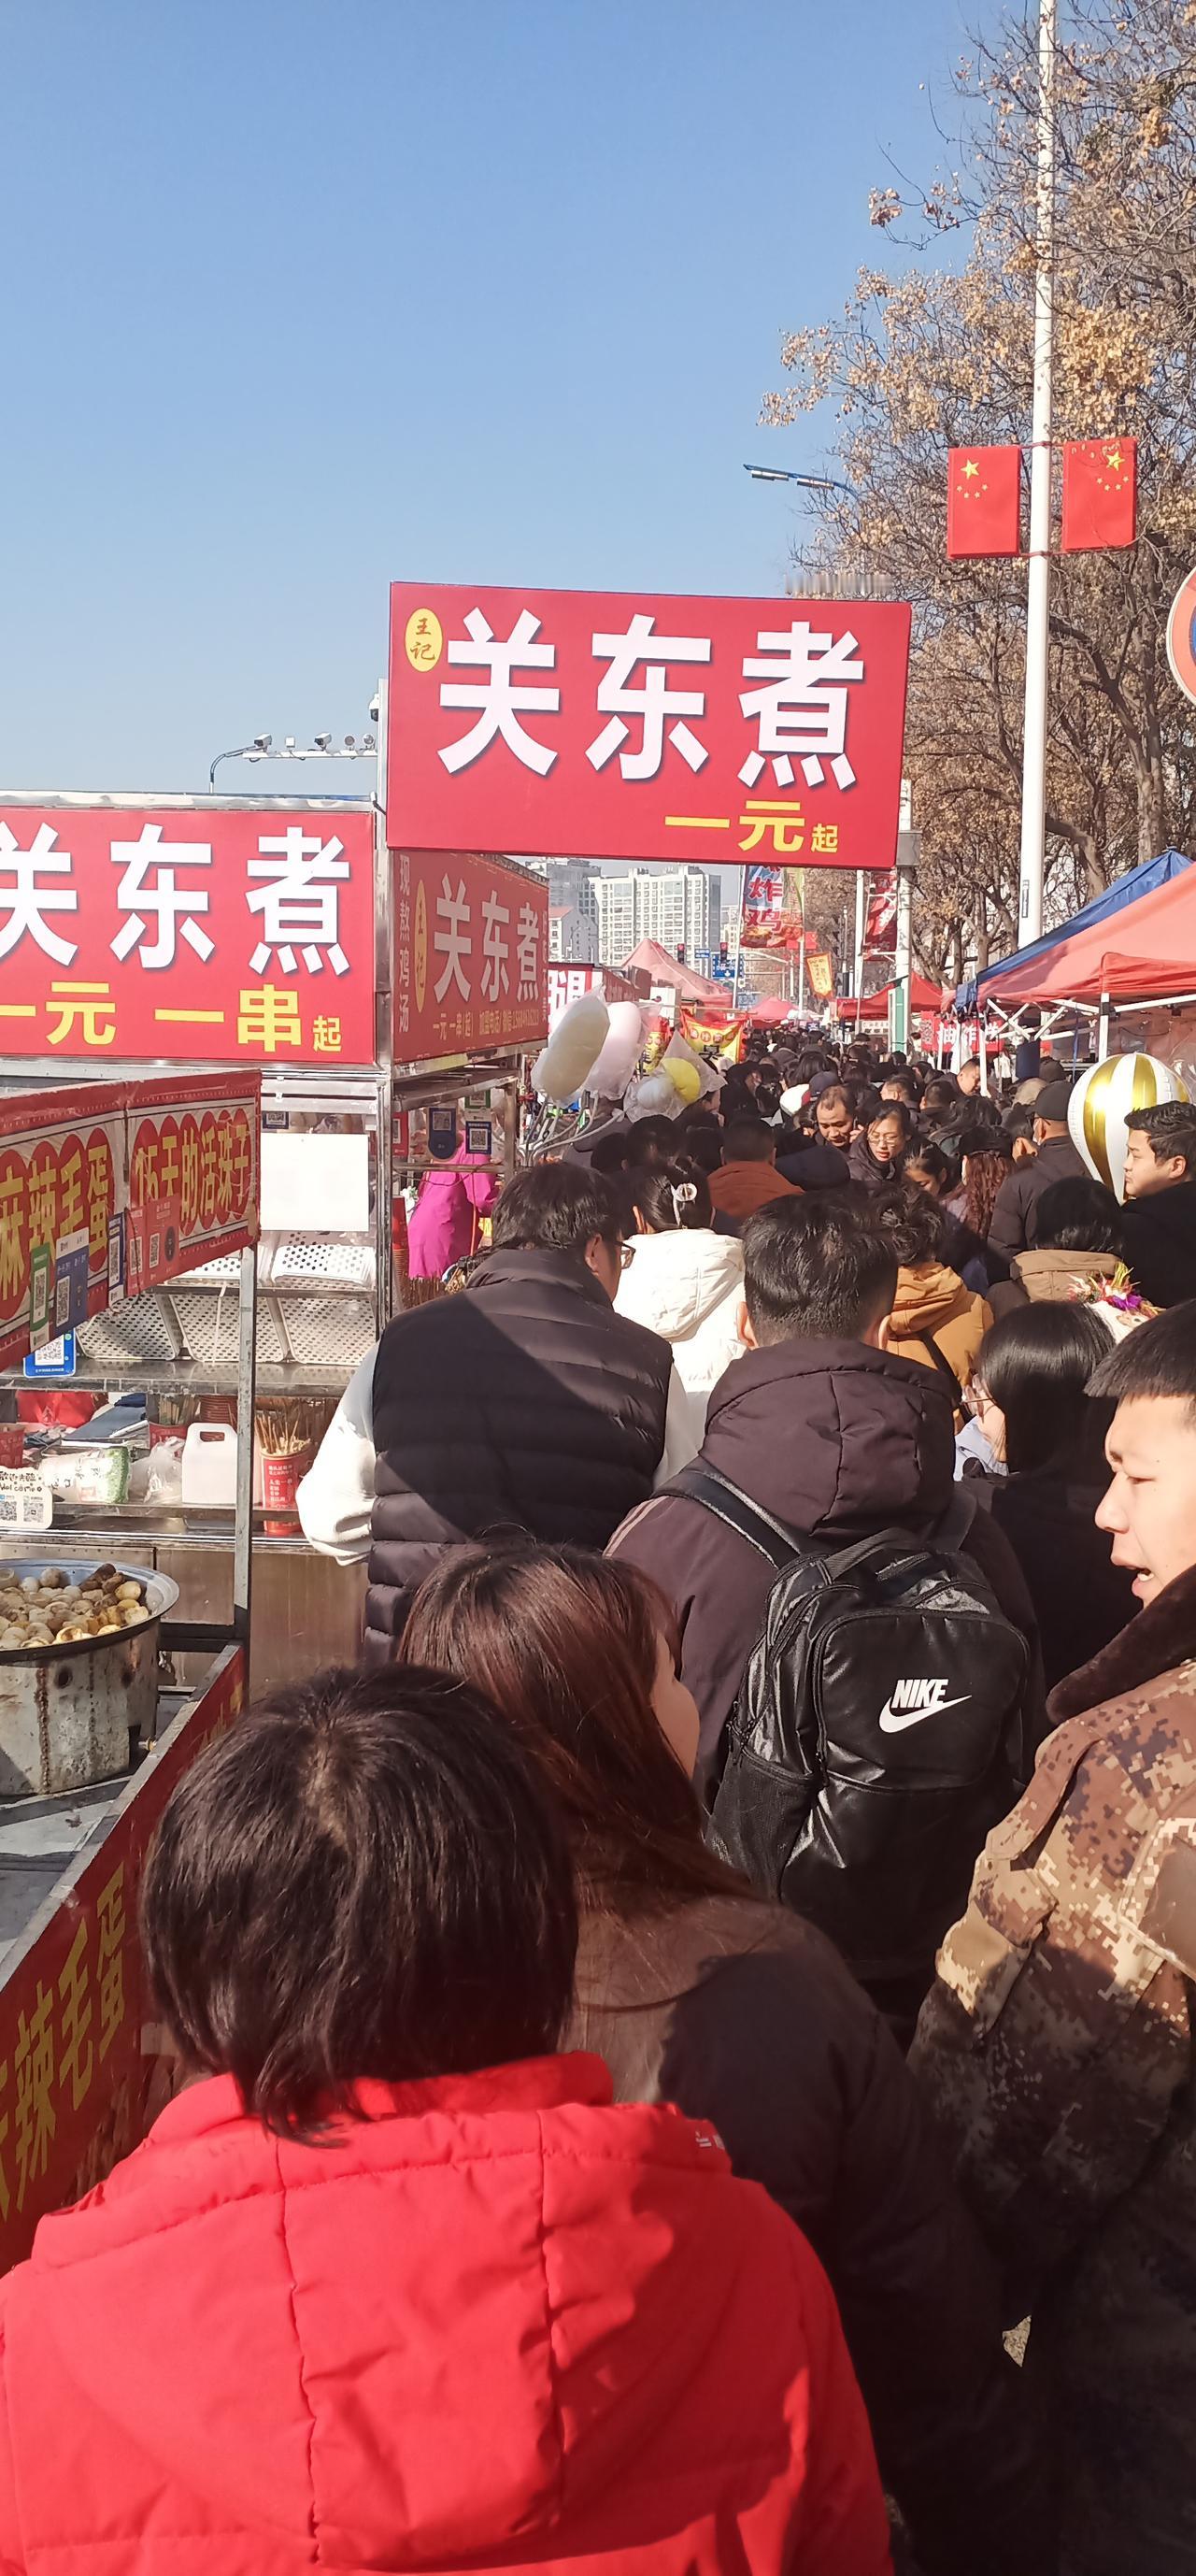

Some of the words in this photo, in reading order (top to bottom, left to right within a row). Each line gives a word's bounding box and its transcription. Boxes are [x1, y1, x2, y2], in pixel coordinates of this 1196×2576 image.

[410, 618, 434, 661] 王记
[437, 607, 863, 790] 关东煮
[664, 800, 838, 853] 一元起
[0, 822, 350, 976] 关东煮
[399, 855, 410, 1032] 现熬鸡汤
[434, 873, 539, 1003] 关东煮
[747, 866, 783, 933] 炸鸡
[890, 1679, 949, 1709] NIKE
[0, 1861, 127, 2222] 辣毛蛋
